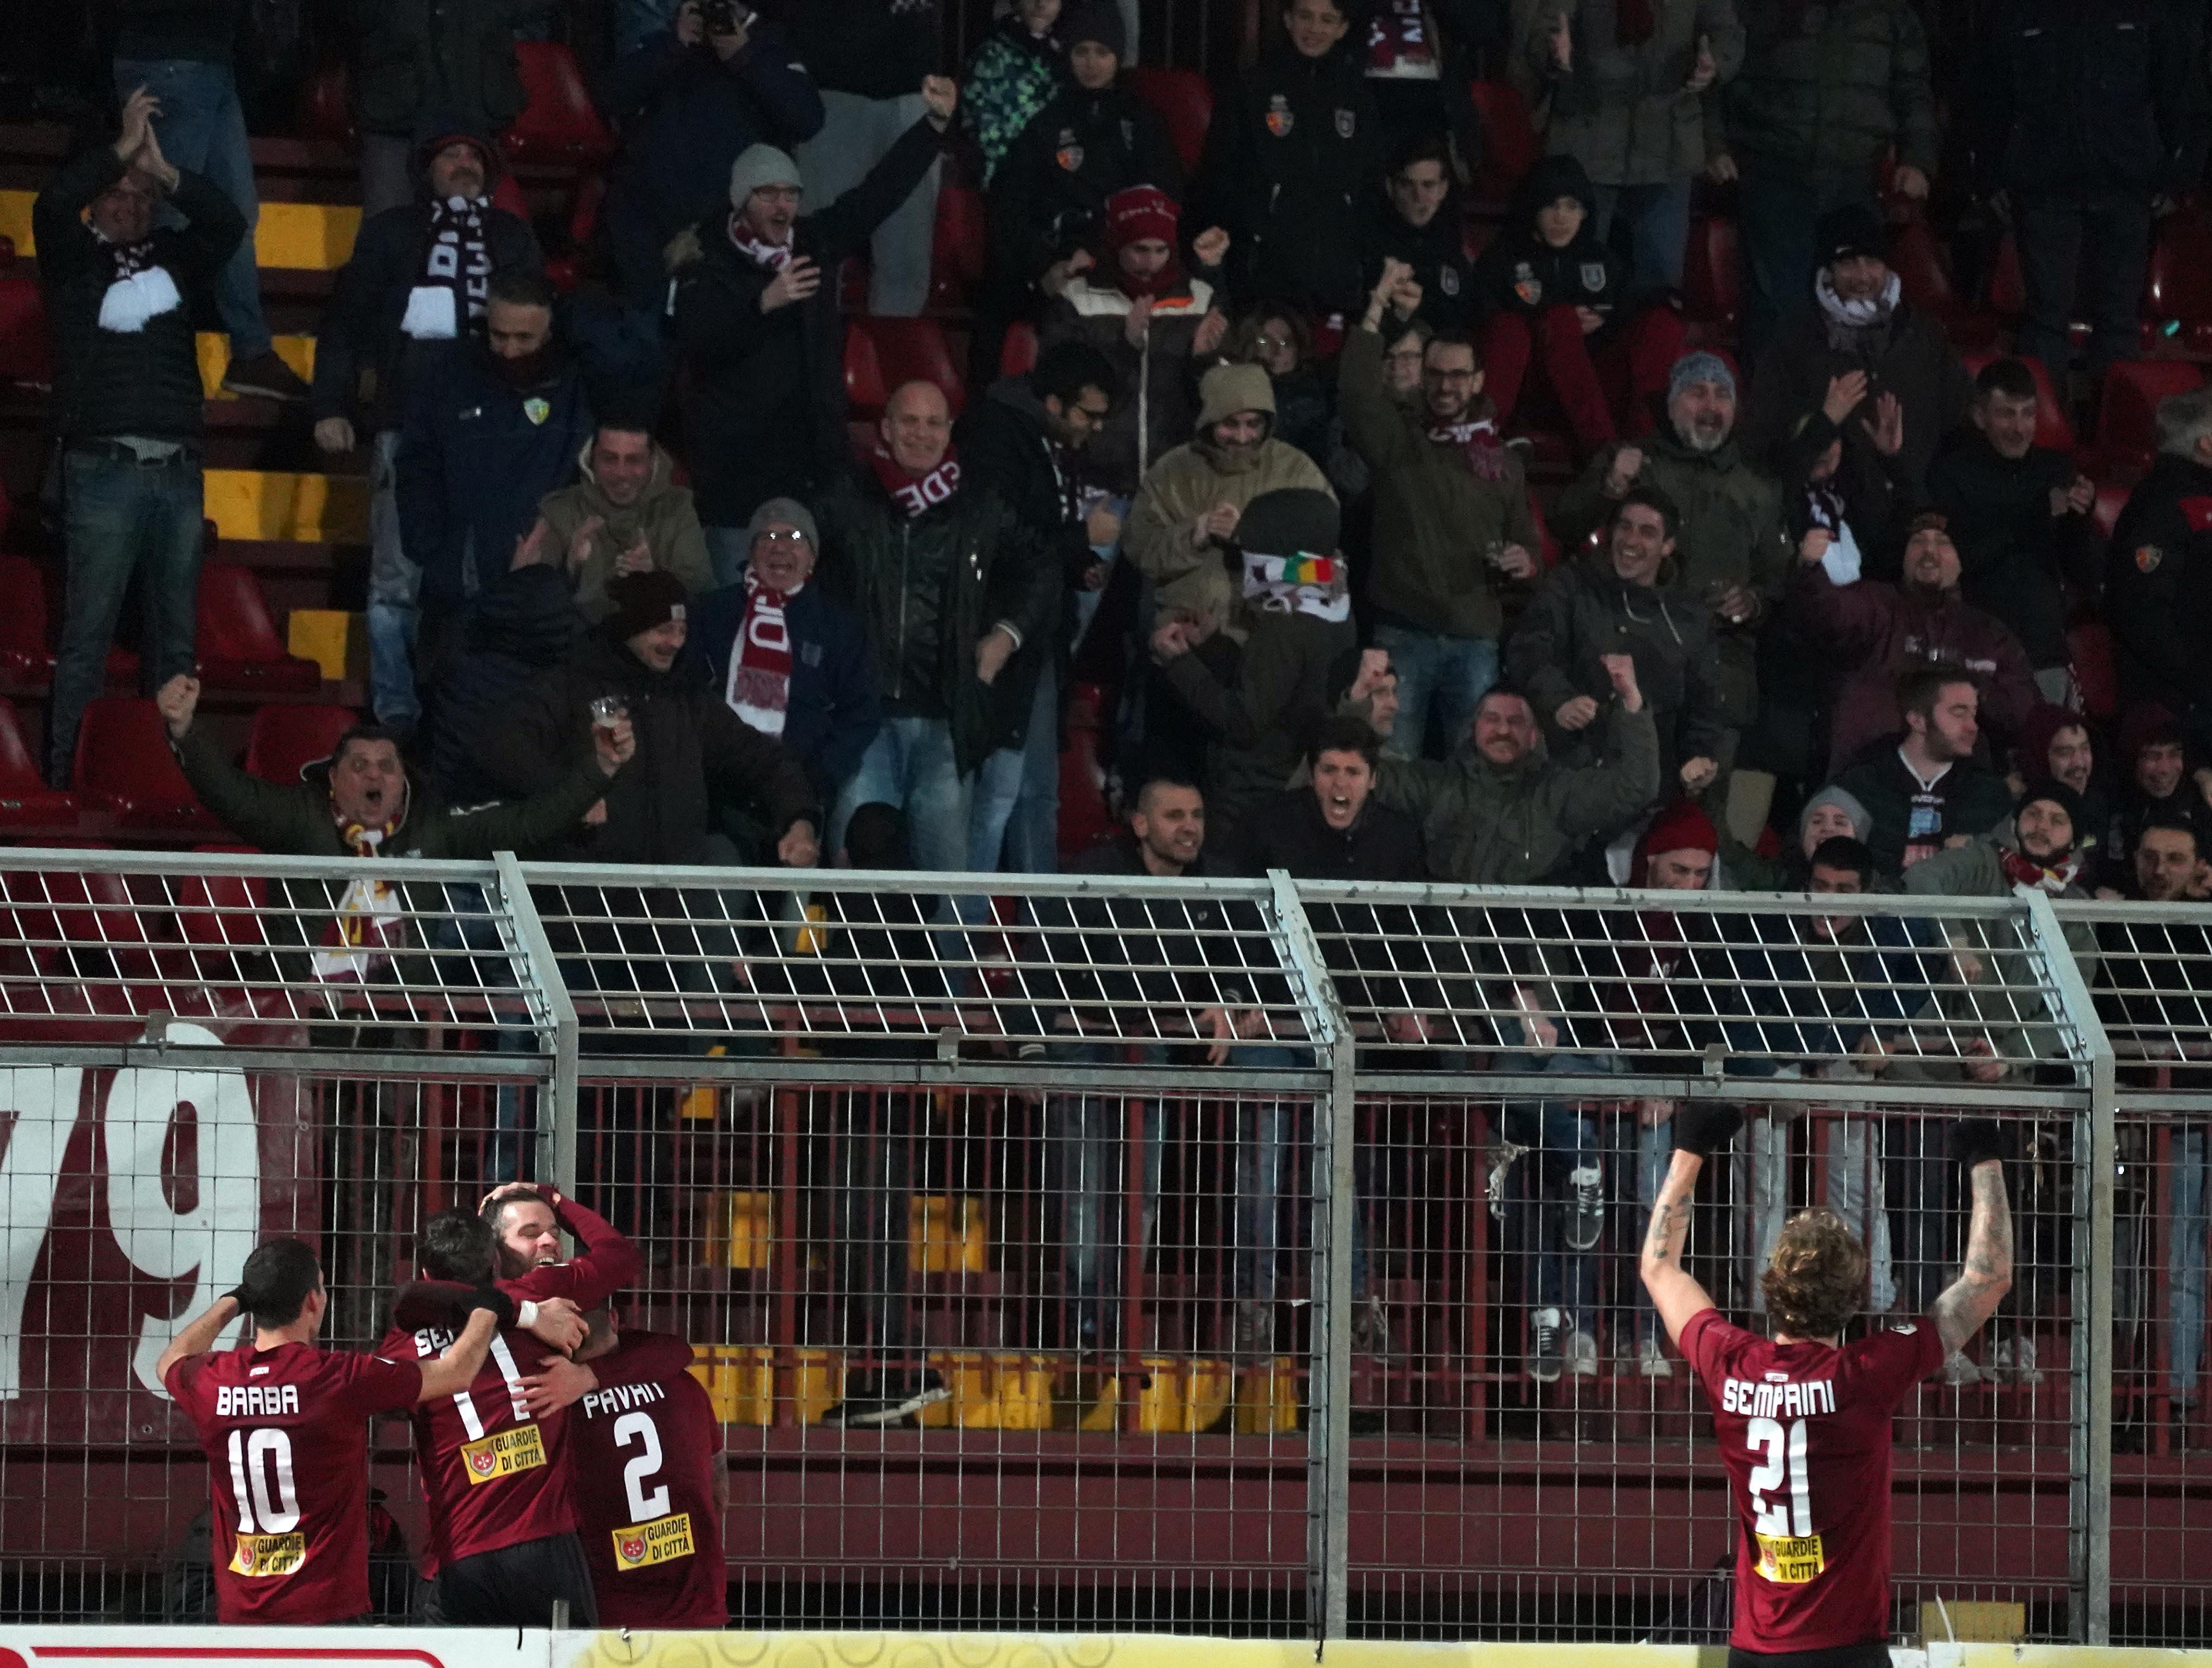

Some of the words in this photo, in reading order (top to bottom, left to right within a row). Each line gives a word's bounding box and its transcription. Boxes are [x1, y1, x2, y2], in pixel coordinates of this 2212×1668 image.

[216, 1385, 299, 1416] BARBA
[1722, 1378, 1836, 1419] SEMPRINI
[496, 1428, 538, 1452] GUARDIE
[502, 1456, 512, 1471] DI
[613, 1411, 671, 1523] 2
[1747, 1417, 1812, 1538] 21
[228, 1428, 300, 1534] 10
[648, 1517, 687, 1541] GUARDIE
[652, 1545, 662, 1560] DI
[664, 1534, 690, 1557] CITTÀ
[1775, 1538, 1818, 1558] GUARDIE
